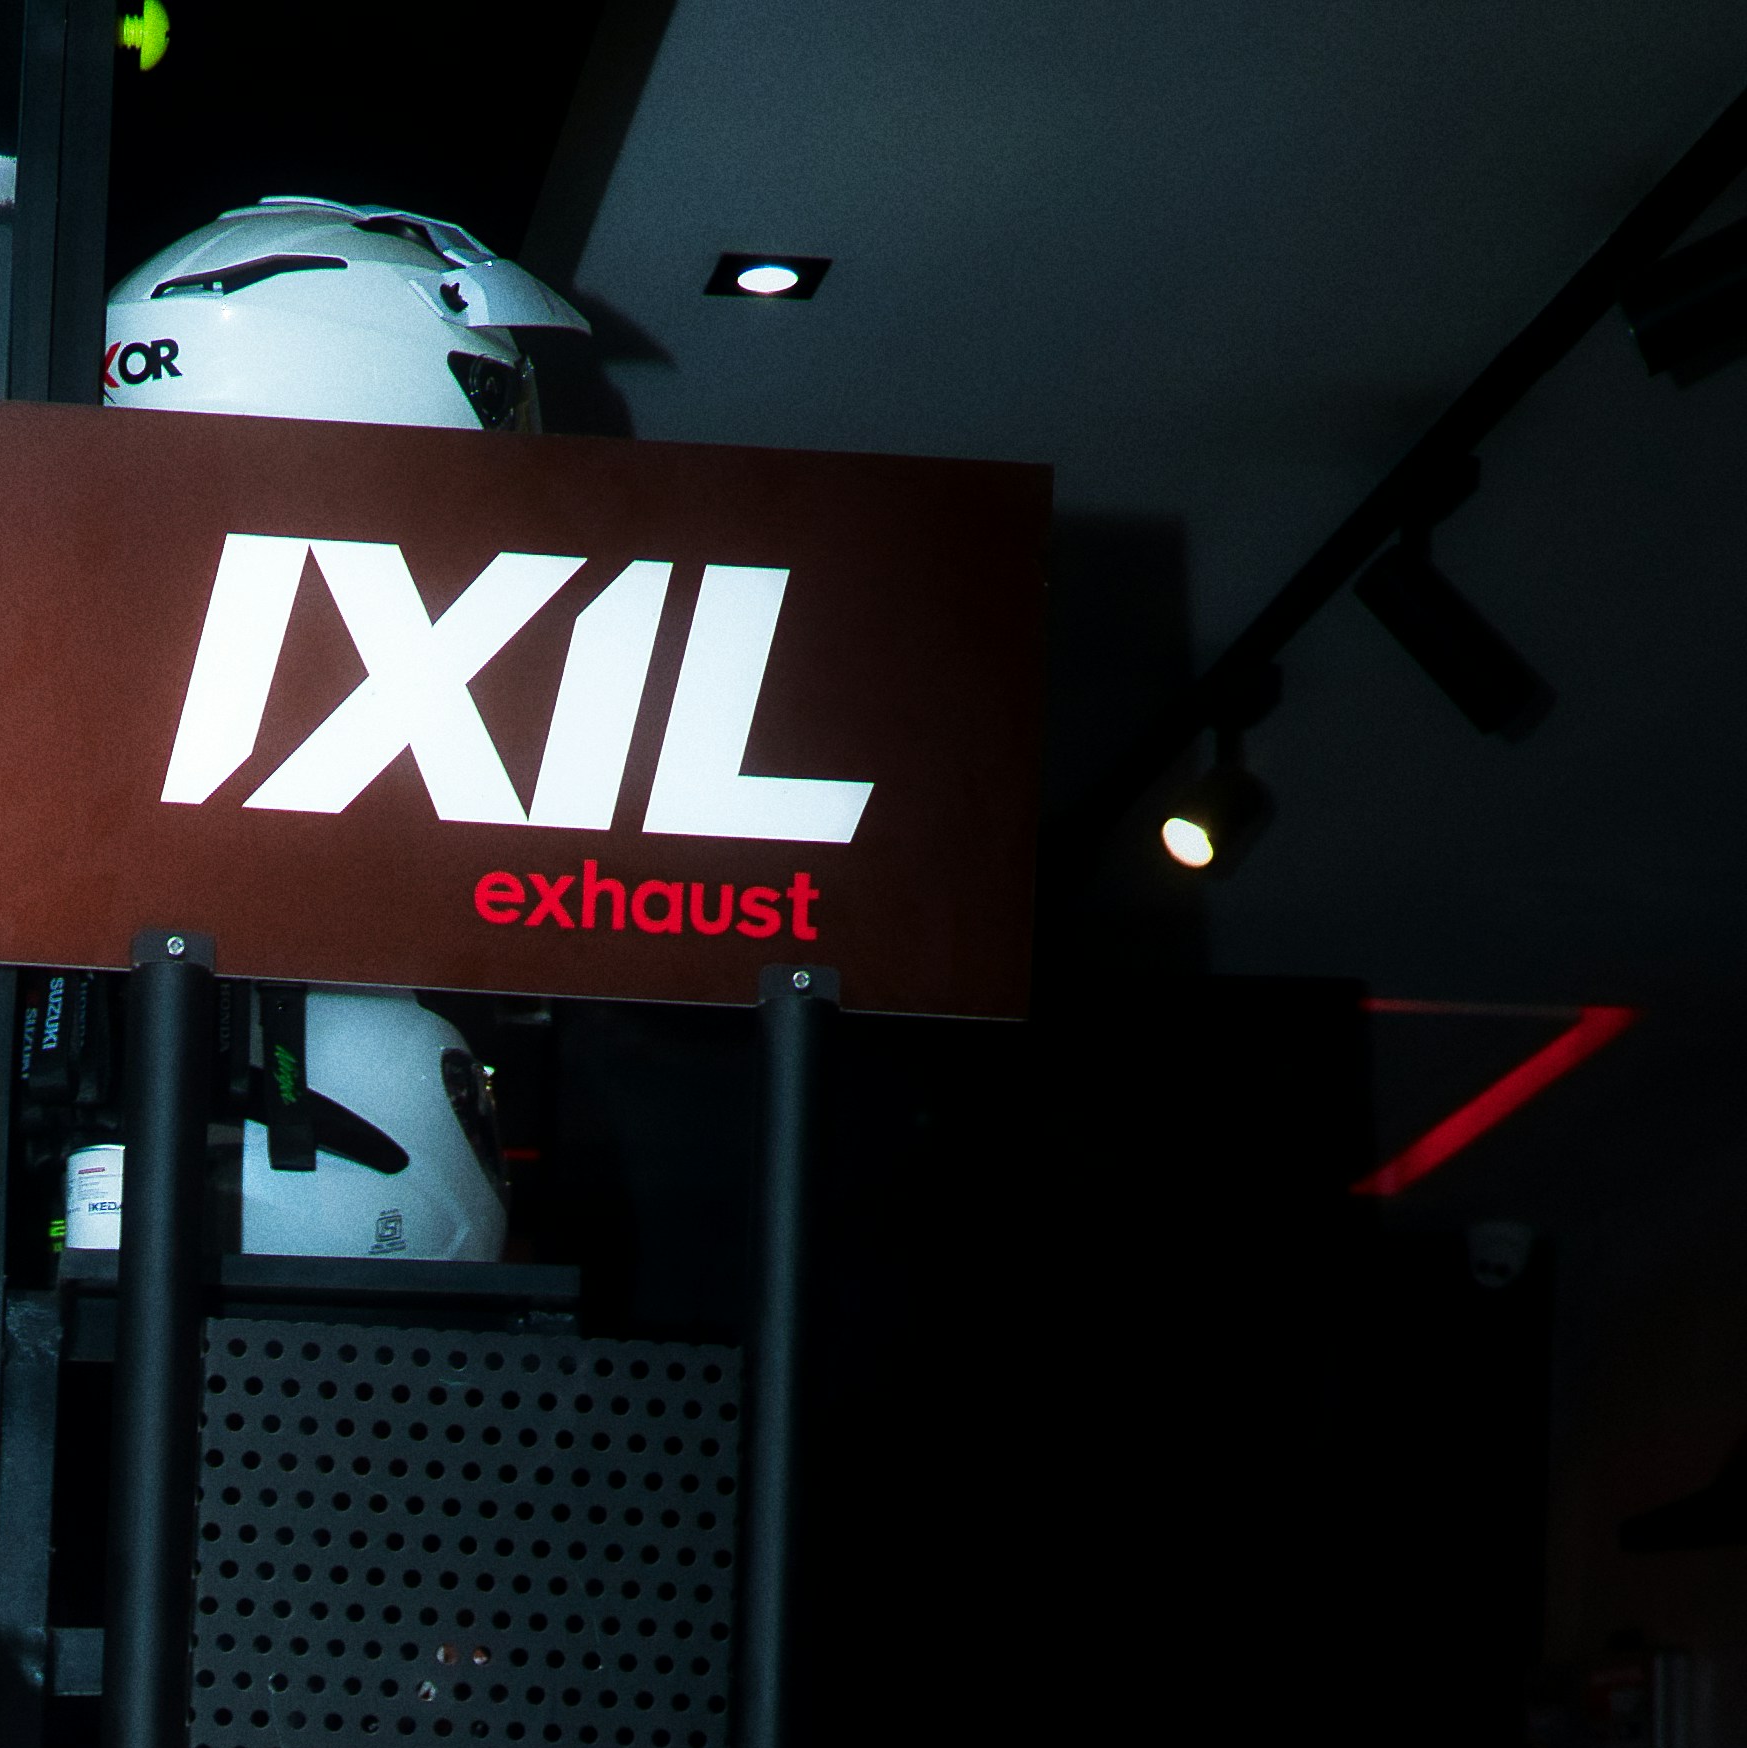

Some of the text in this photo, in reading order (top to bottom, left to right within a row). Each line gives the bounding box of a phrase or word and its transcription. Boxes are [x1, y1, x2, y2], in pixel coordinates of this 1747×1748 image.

[160, 532, 874, 844] IXIL
[474, 859, 820, 941] exhaust
[41, 976, 65, 1050] SUZUKI
[218, 982, 232, 1052] HONDA
